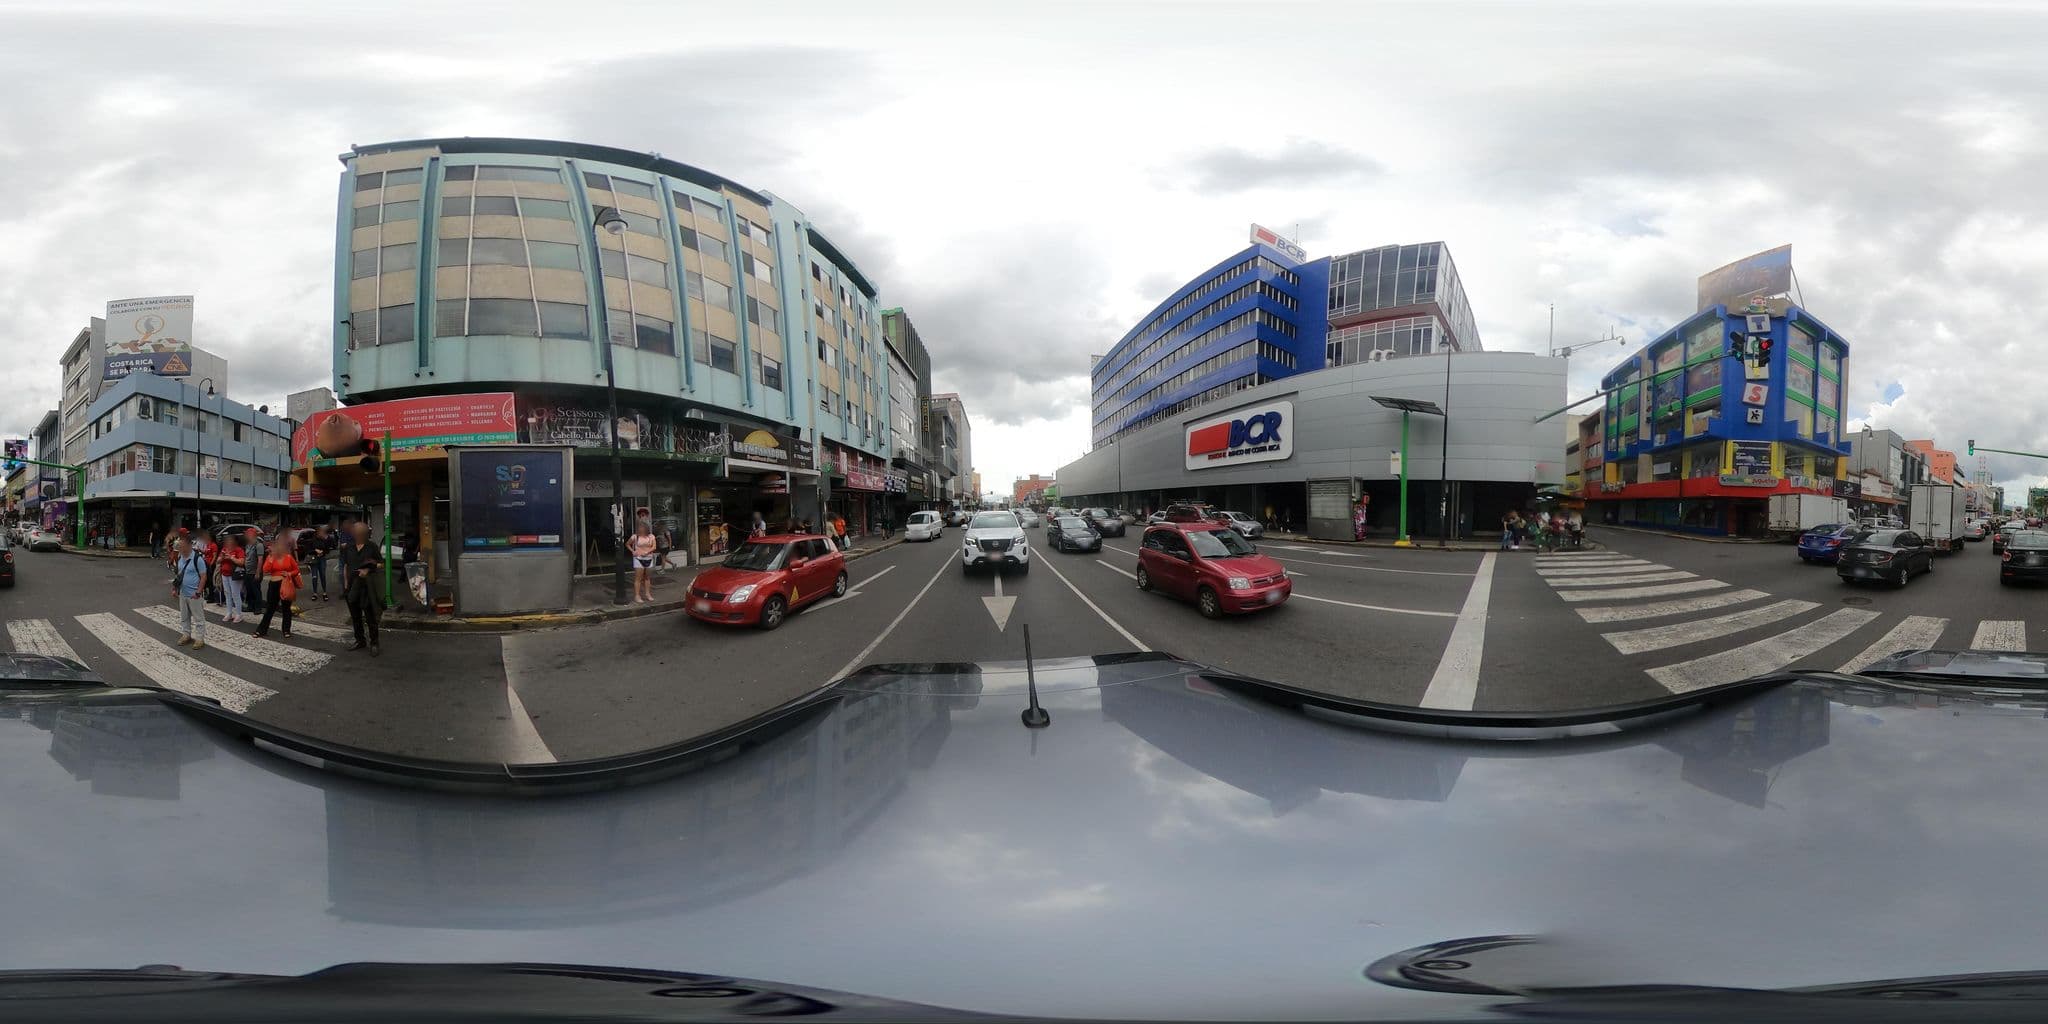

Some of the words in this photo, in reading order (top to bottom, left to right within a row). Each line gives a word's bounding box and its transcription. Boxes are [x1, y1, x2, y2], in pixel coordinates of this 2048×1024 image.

[1277, 238, 1305, 263] BCR
[110, 360, 134, 368] COSTA
[557, 406, 605, 418] Scissors
[1229, 411, 1282, 448] BCR
[1244, 447, 1252, 455] DE
[1252, 445, 1267, 453] COSTA
